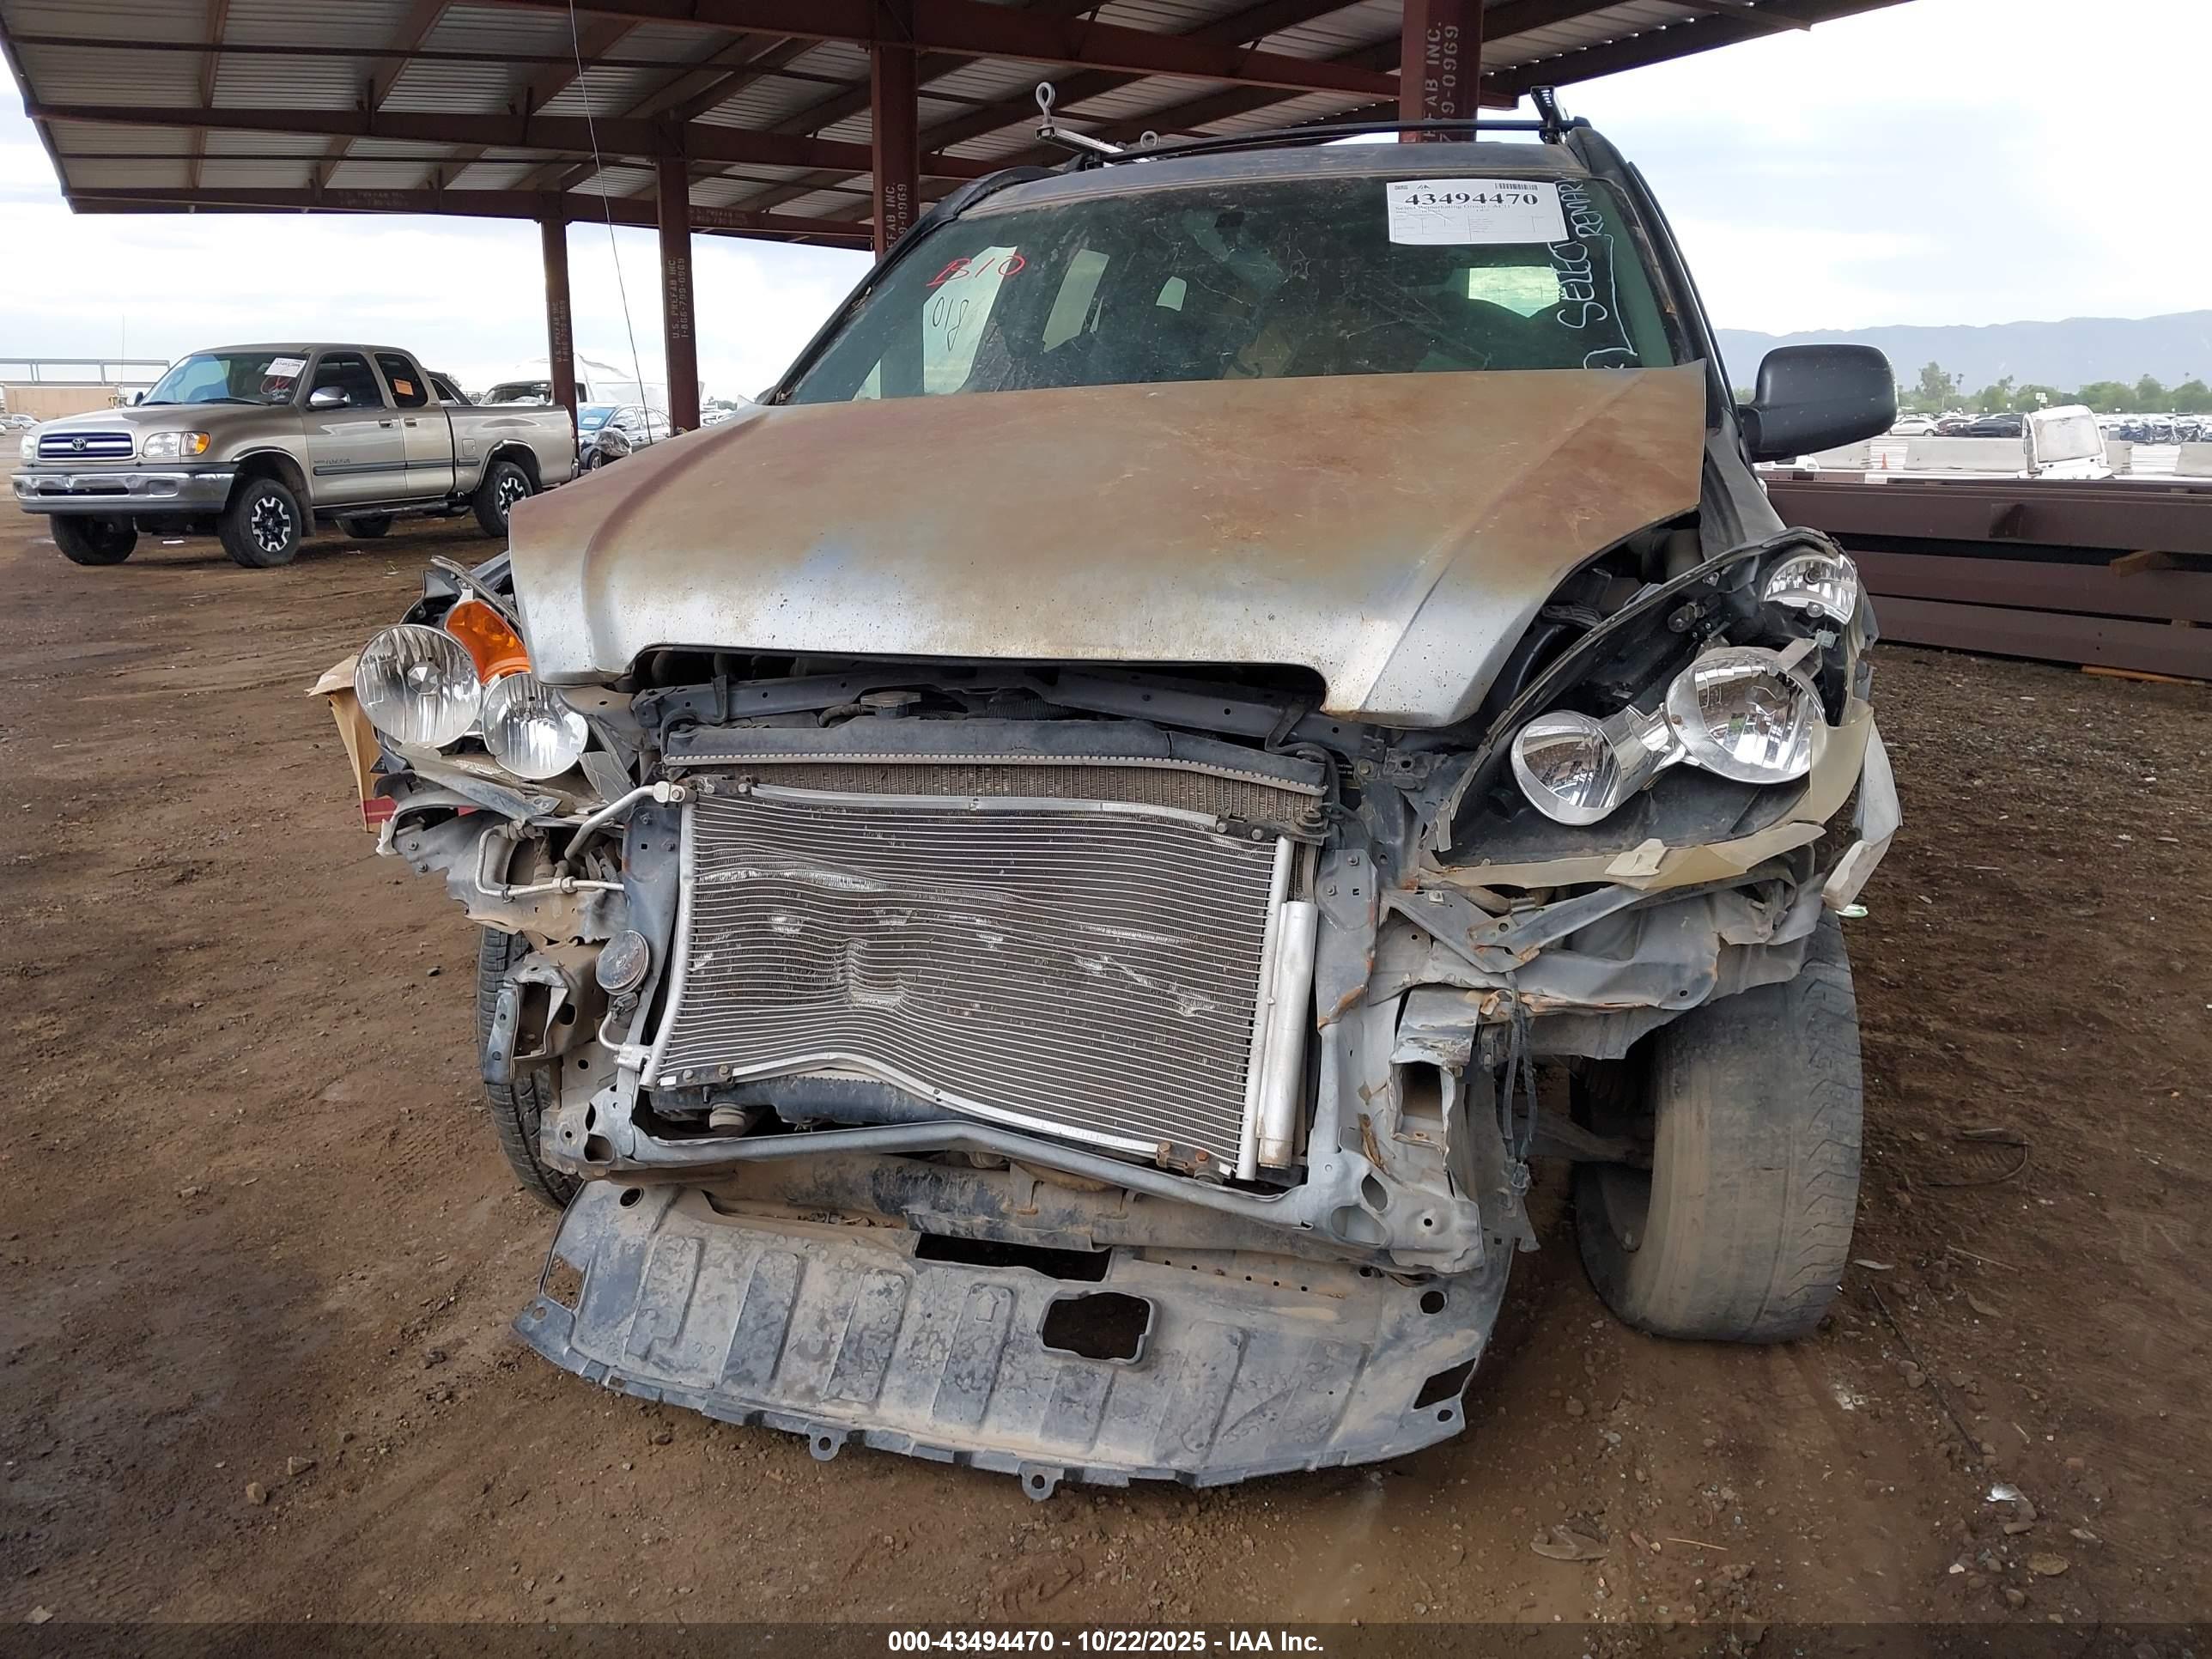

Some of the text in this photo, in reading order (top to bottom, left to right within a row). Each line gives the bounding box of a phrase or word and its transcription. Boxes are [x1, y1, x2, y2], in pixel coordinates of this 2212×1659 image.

[1426, 21, 1442, 65] INC.
[886, 182, 896, 208] INC.
[1405, 192, 1538, 205] 43494470
[926, 254, 1026, 287] B10
